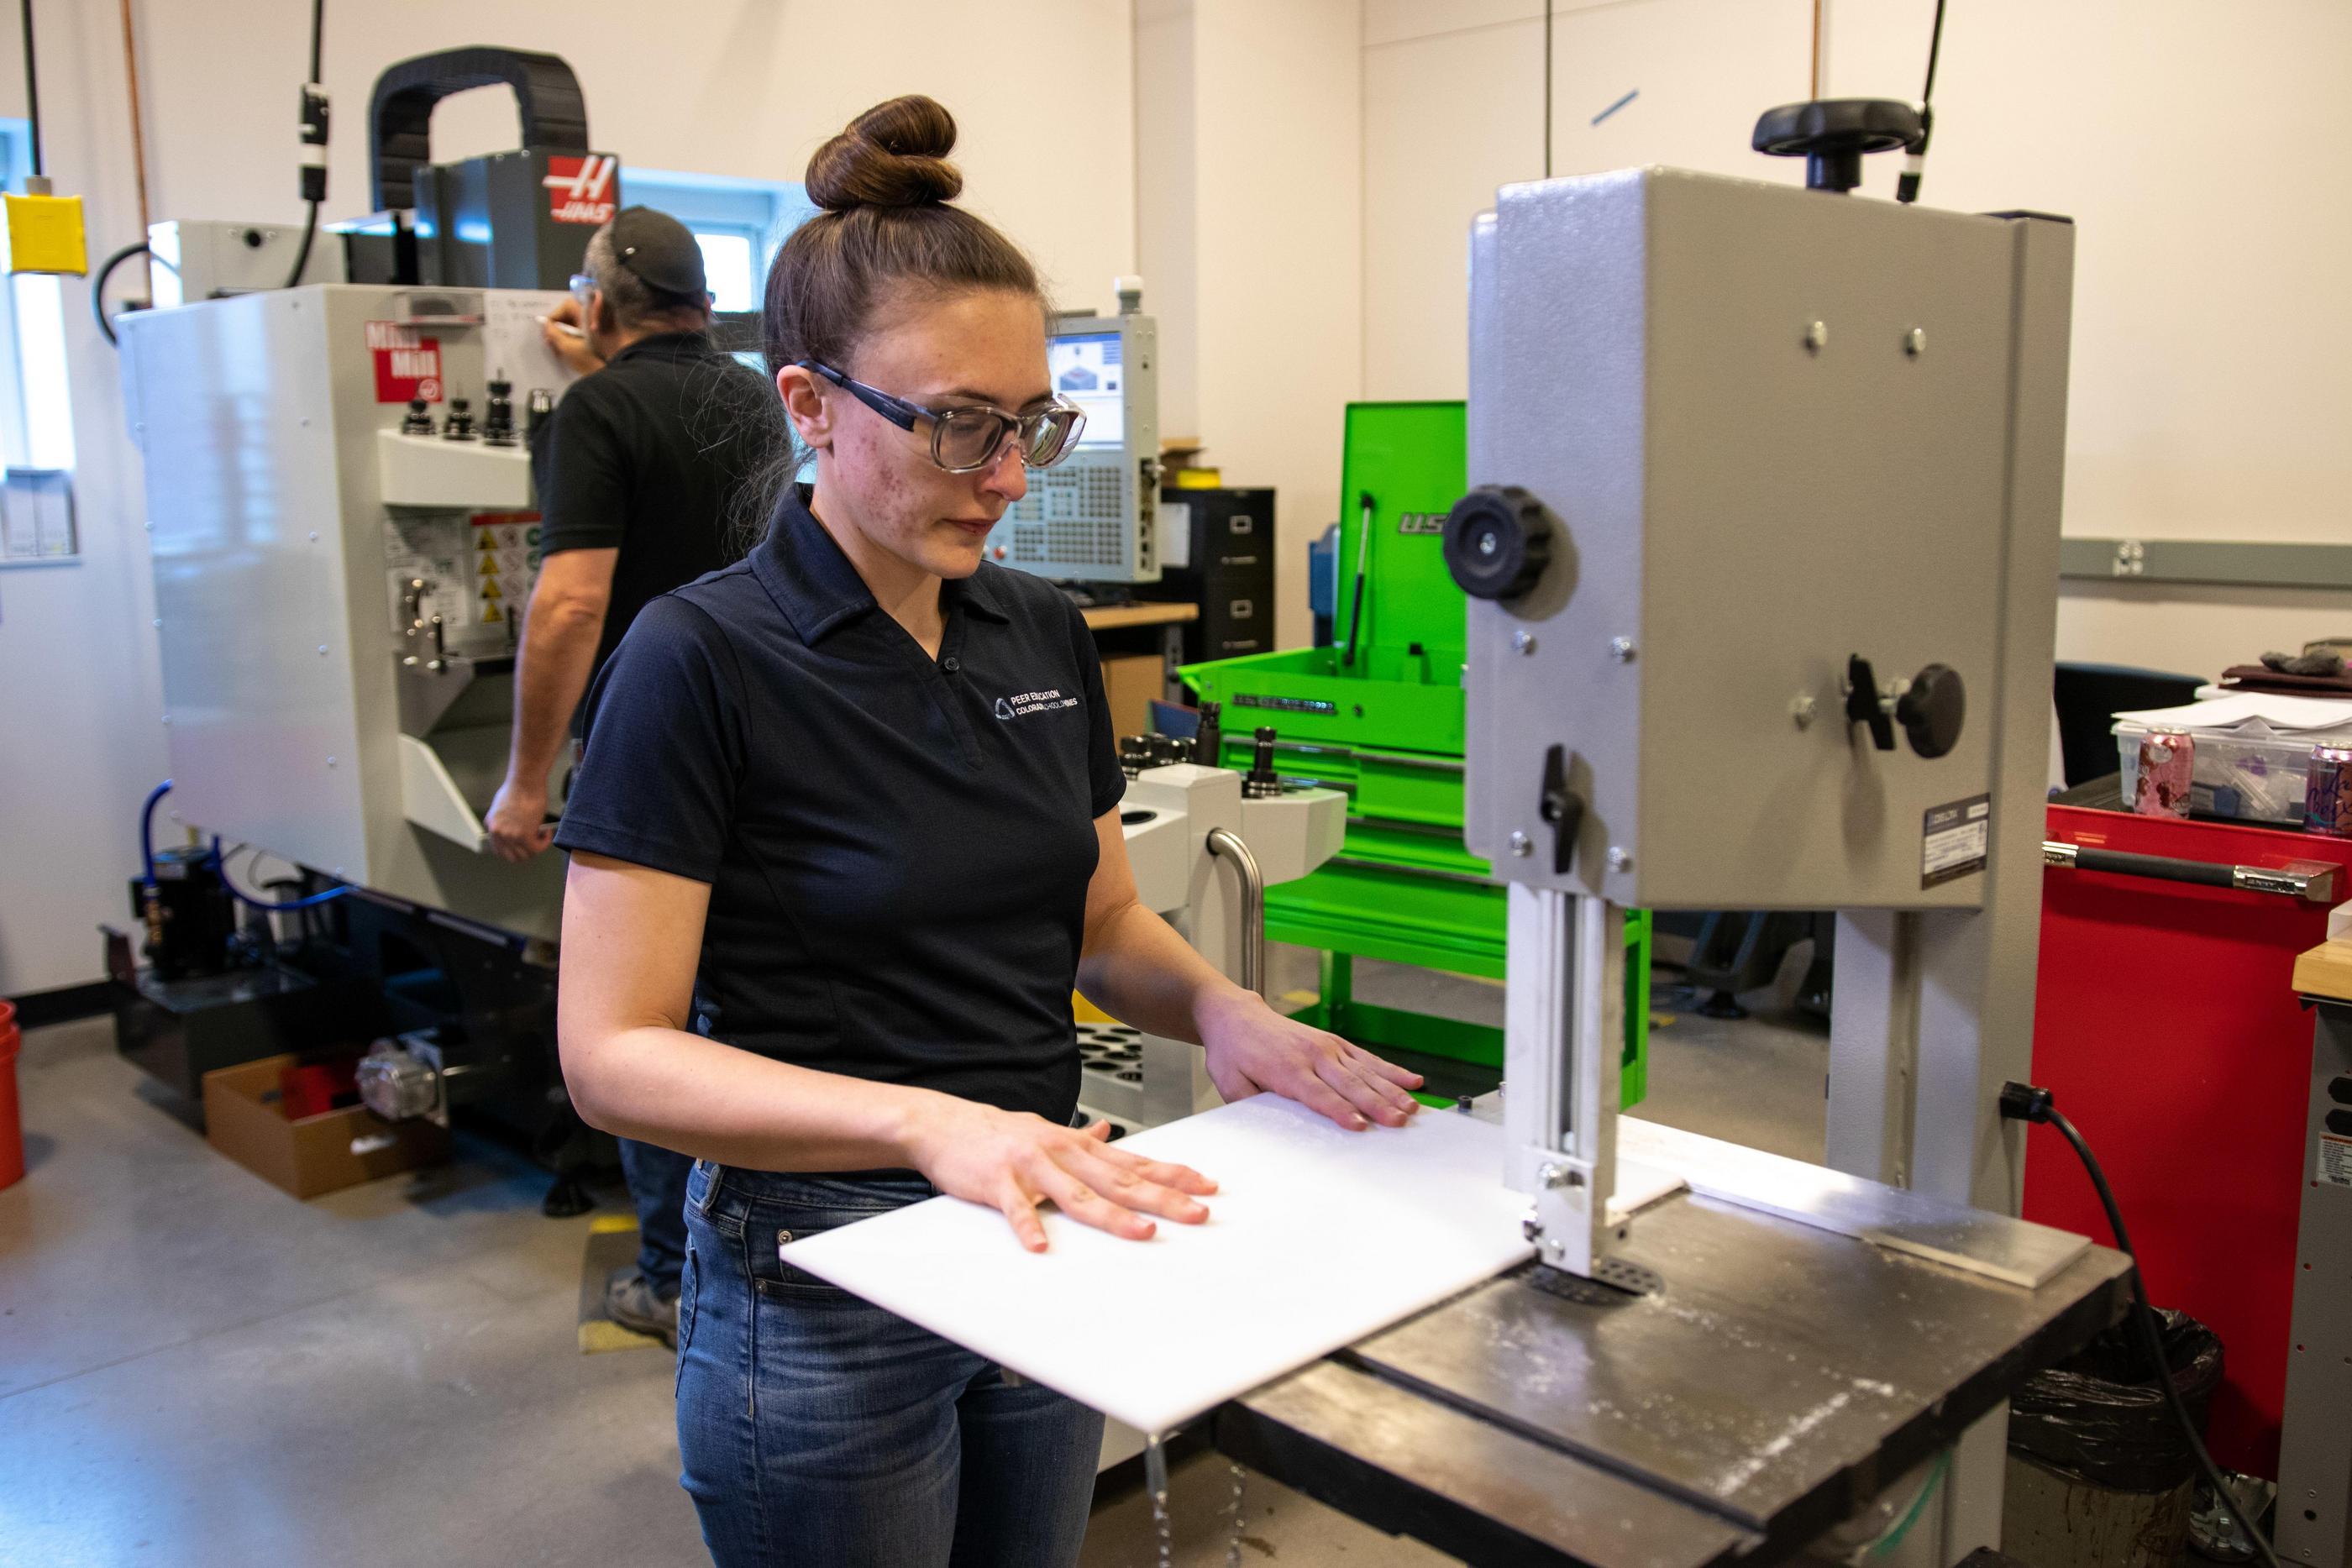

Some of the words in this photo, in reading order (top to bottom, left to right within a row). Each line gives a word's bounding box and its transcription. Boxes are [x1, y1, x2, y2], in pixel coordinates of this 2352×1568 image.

[550, 202, 617, 223] HAAS
[391, 350, 437, 378] Mill
[1011, 694, 1031, 705] PEER
